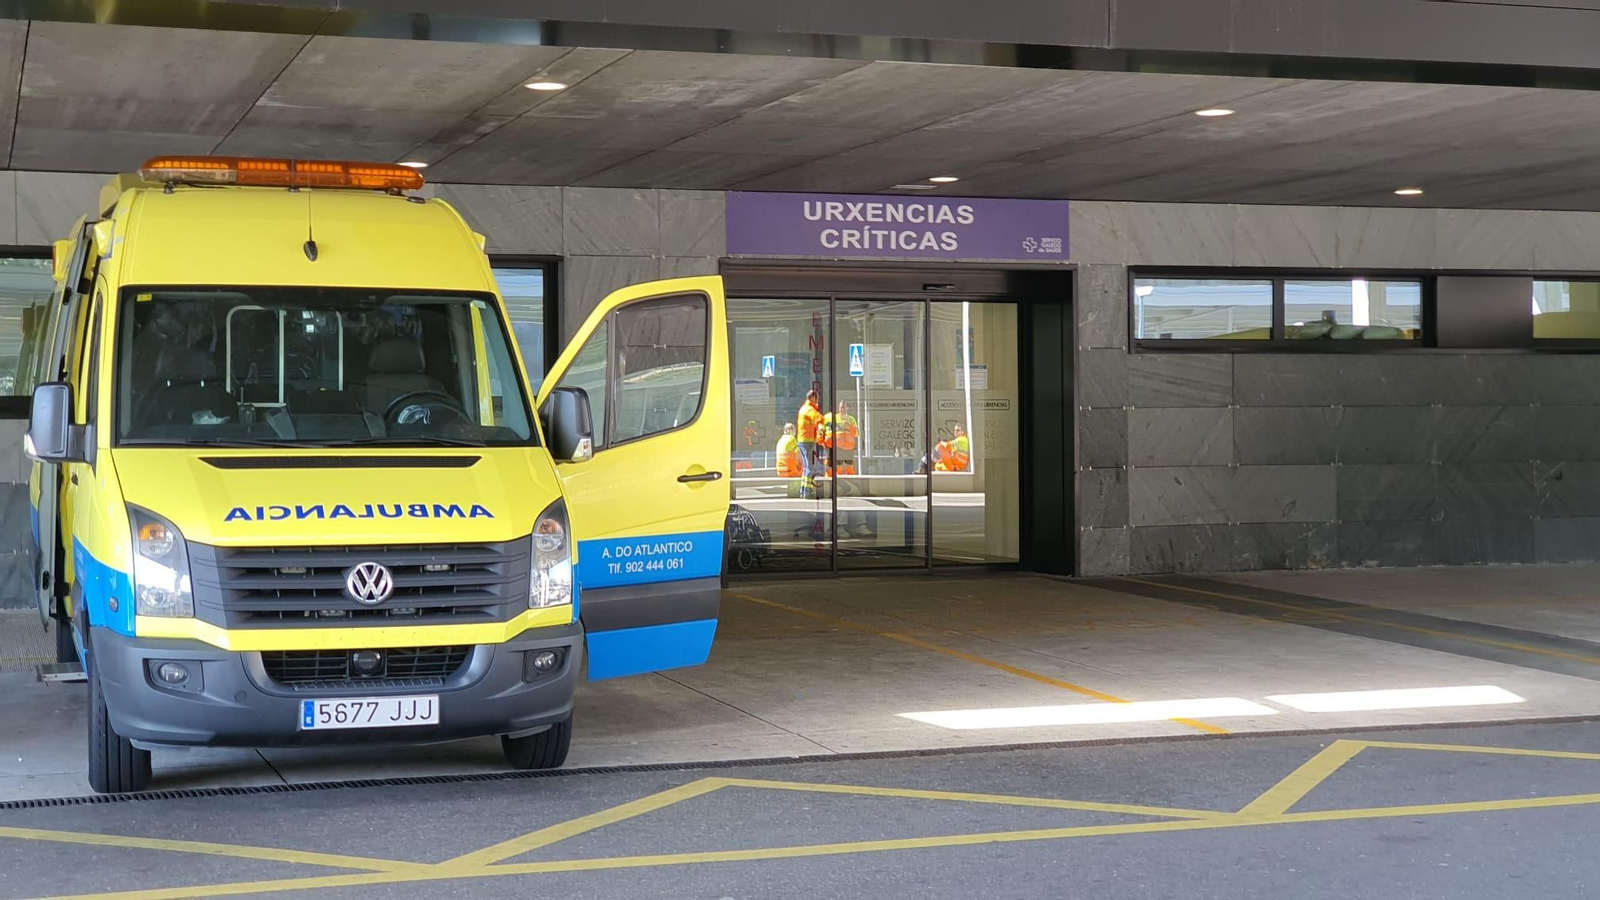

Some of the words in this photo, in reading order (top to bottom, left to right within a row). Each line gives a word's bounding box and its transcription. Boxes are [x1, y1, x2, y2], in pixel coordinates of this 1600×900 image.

[803, 201, 975, 225] URXENCIAS
[820, 226, 958, 251] CRÍTICAS
[602, 547, 612, 559] A.
[615, 545, 632, 558] DO
[634, 541, 693, 556] ATLANTICO
[625, 561, 643, 573] 902
[646, 559, 664, 571] 444
[666, 558, 684, 570] 061
[319, 702, 379, 724] 5677
[390, 700, 432, 721] JJJ
